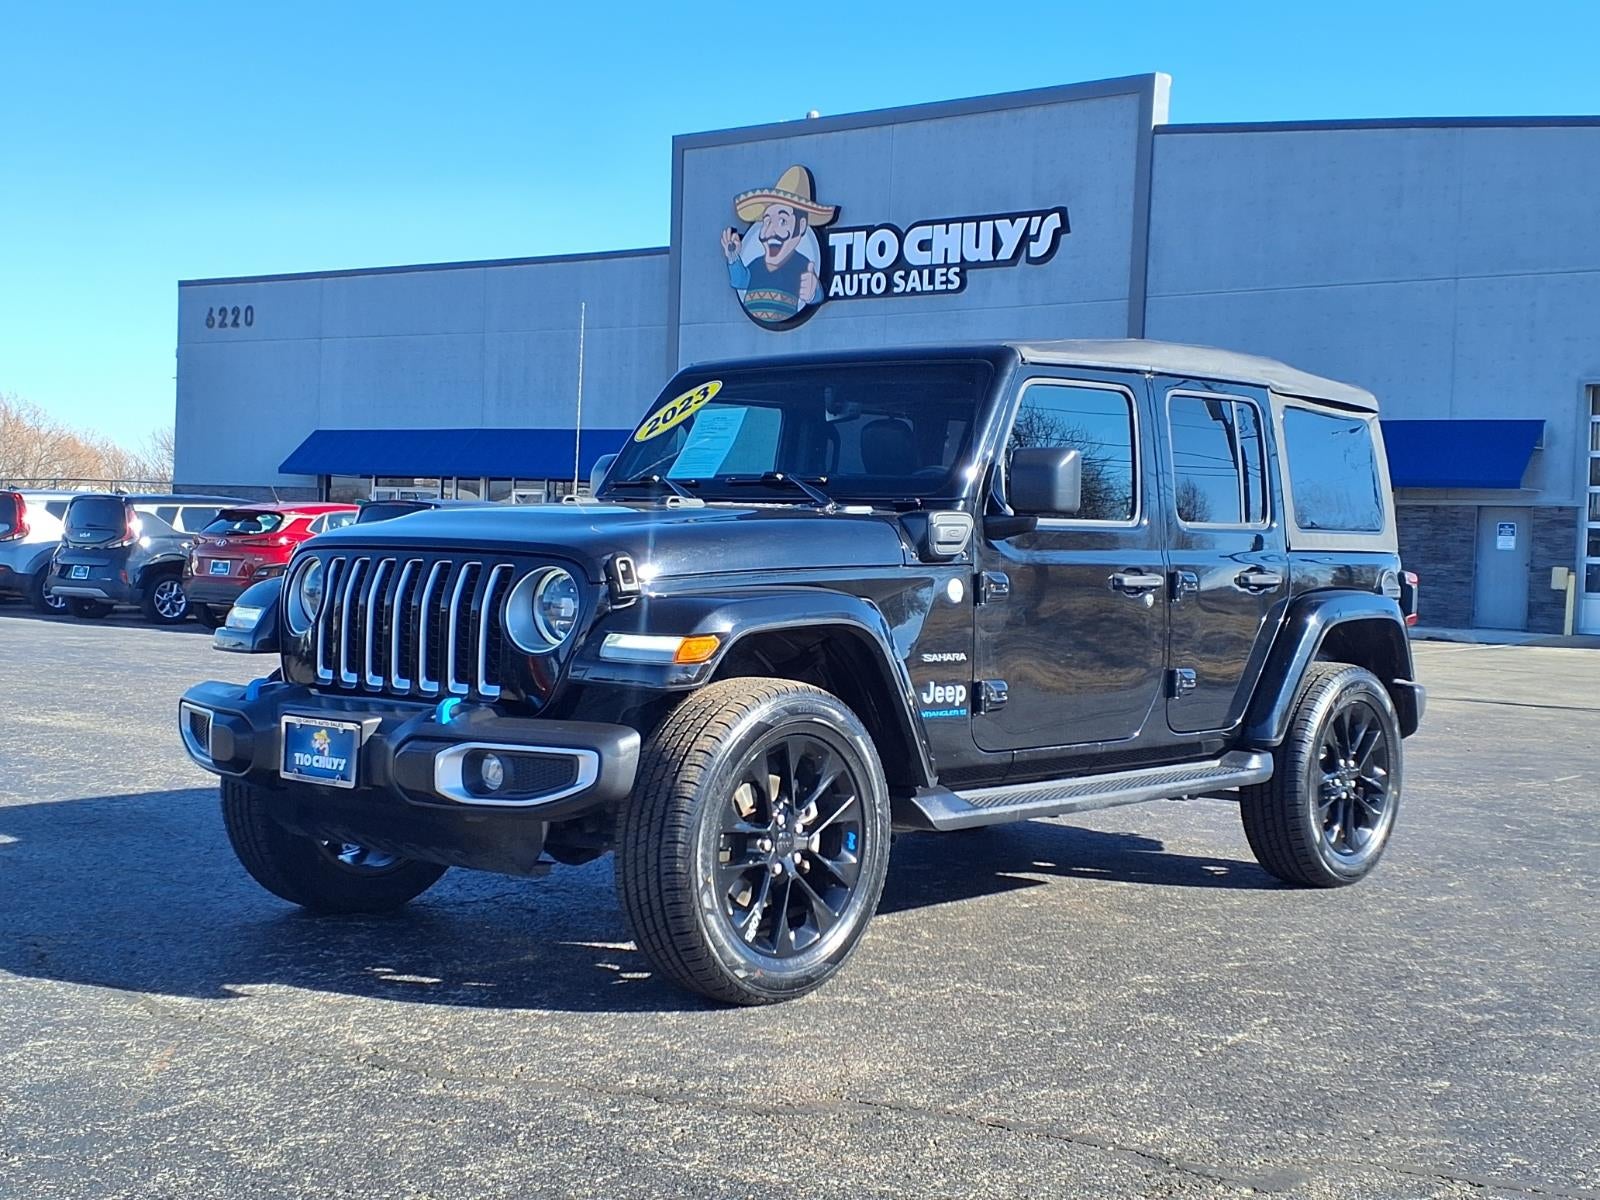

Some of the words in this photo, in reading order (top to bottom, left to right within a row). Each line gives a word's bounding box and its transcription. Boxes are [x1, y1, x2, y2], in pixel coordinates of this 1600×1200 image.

[828, 229, 898, 271] TIO
[903, 213, 1061, 262] CHUY'S
[829, 271, 887, 297] AUTO
[893, 267, 960, 294] SALES
[205, 305, 254, 329] 6220
[645, 386, 709, 437] 2023
[921, 652, 967, 662] SAHARA
[921, 681, 967, 706] Jeep
[295, 753, 311, 766] TIO
